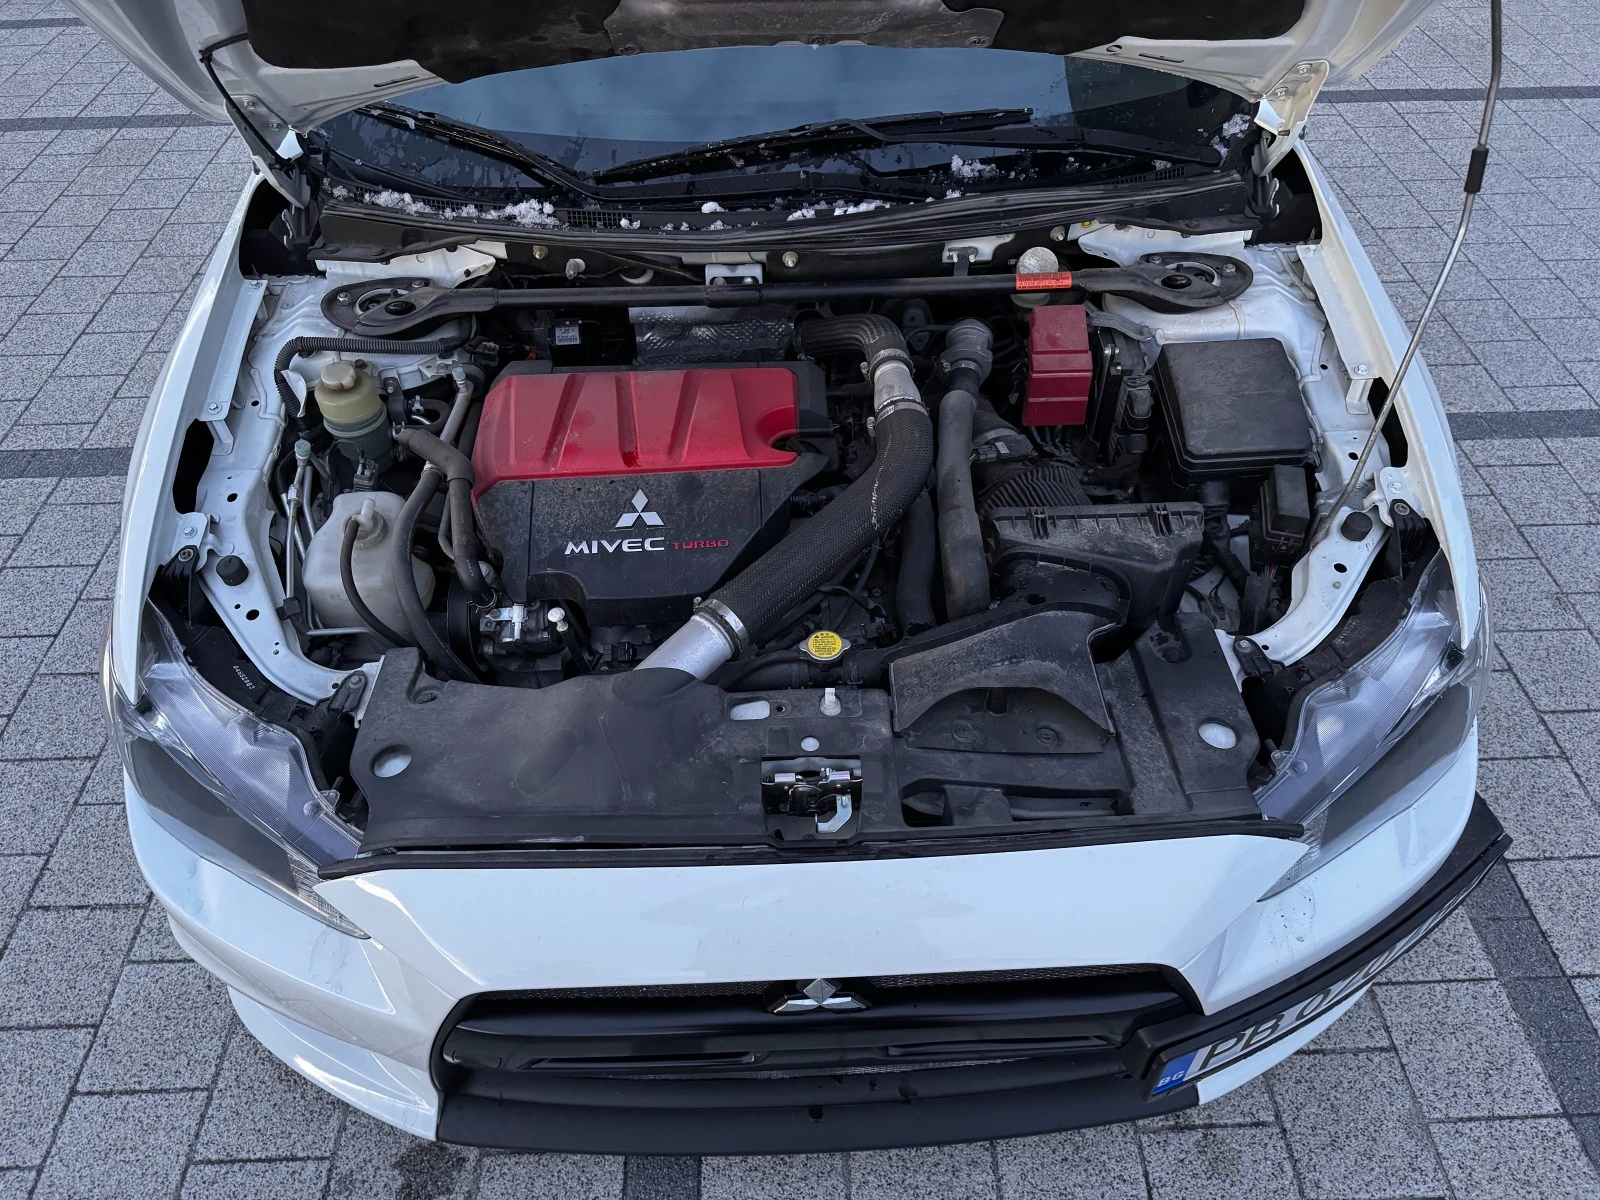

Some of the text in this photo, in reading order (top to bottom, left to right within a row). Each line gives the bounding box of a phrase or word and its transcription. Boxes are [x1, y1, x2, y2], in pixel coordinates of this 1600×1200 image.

[564, 537, 729, 555] MIVEC TURBO
[1199, 1013, 1283, 1071] PB
[1157, 1071, 1185, 1088] BG
